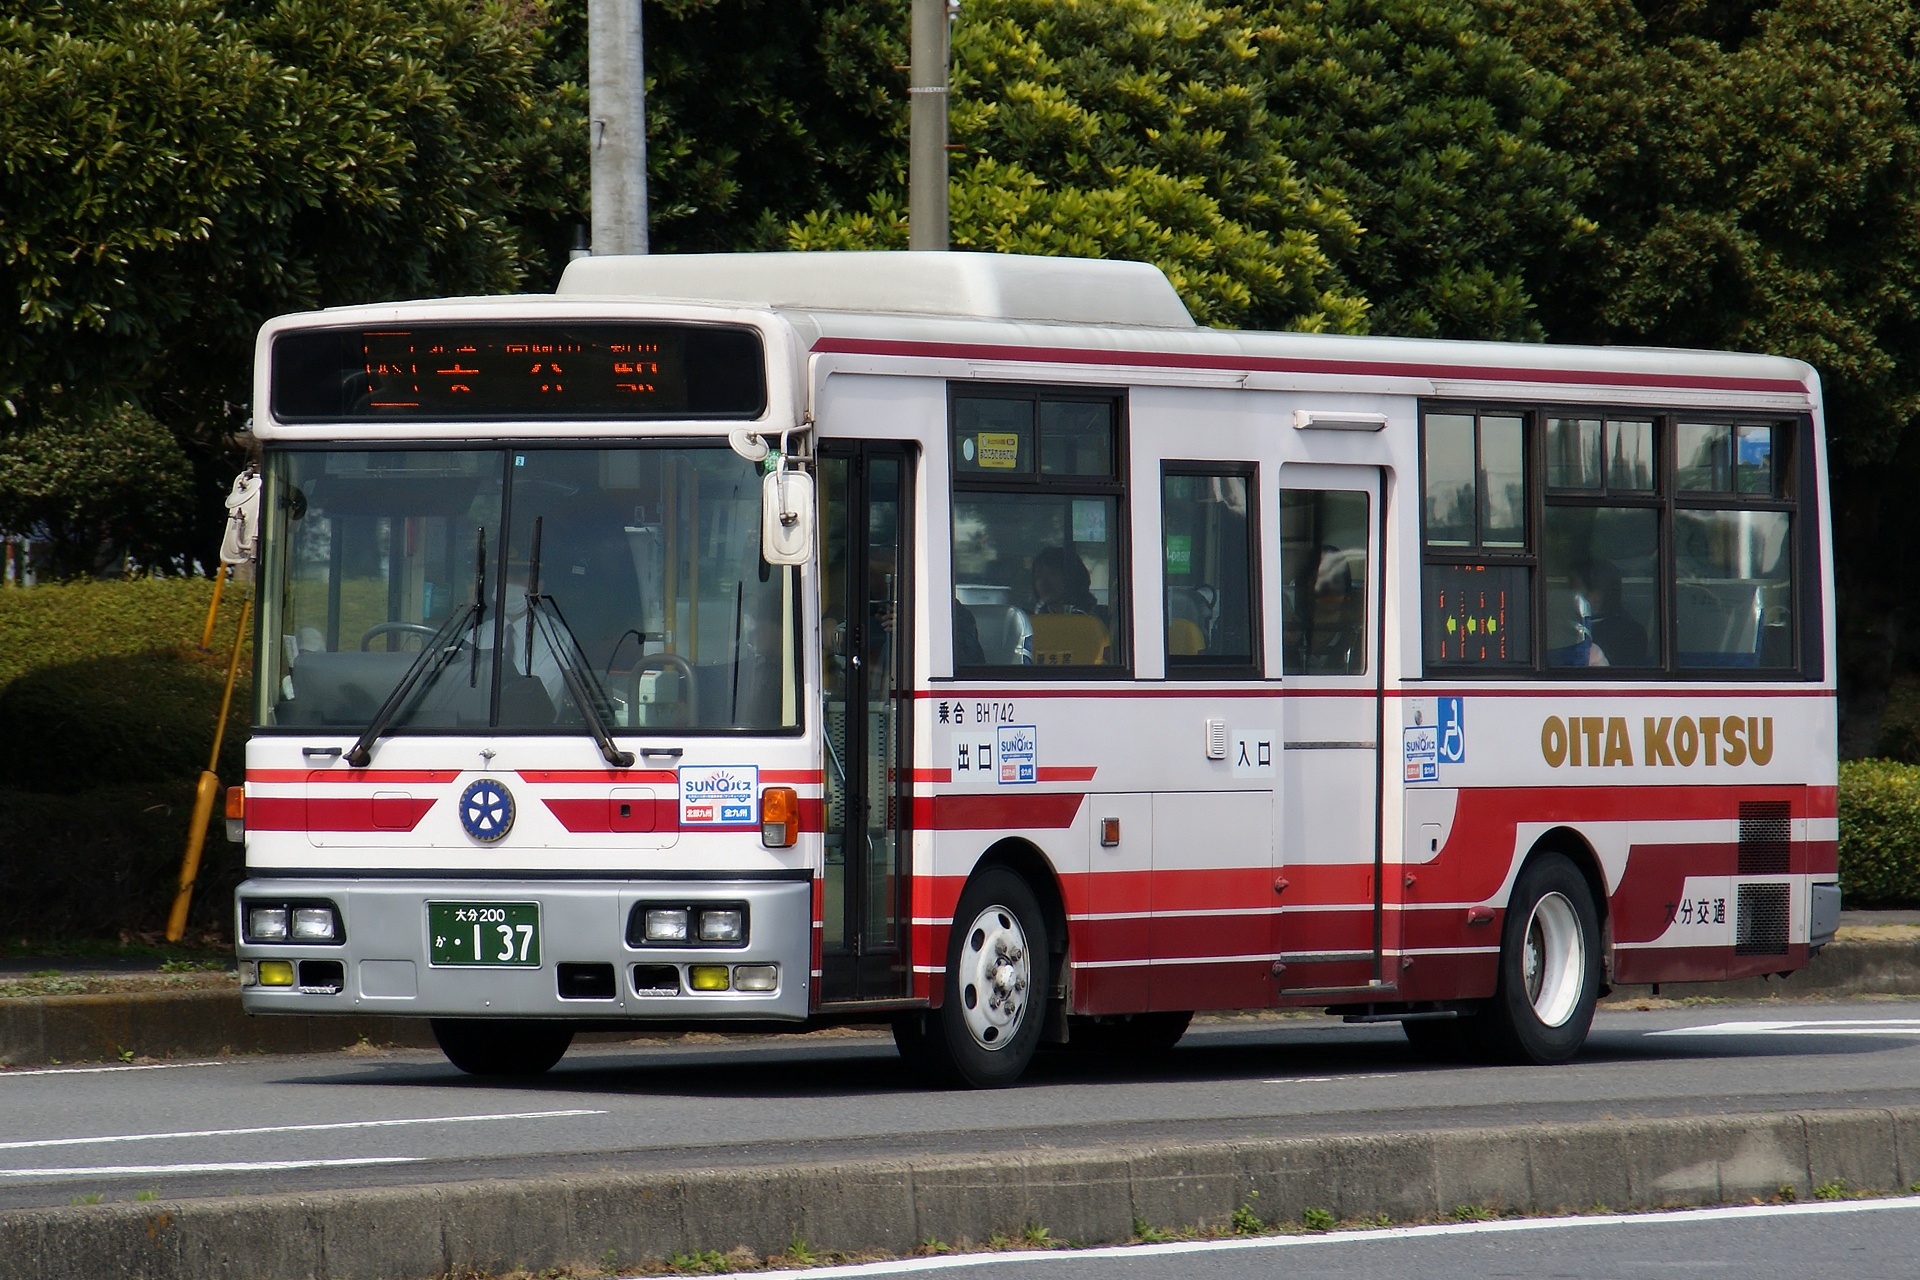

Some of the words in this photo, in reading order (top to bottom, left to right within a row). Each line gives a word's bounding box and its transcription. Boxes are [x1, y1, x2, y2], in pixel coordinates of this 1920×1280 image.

[939, 701, 965, 724] 乗合
[976, 702, 1014, 723] BH742
[1541, 715, 1634, 768] OITA
[1643, 715, 1774, 767] KOTSU
[957, 743, 992, 771] 出口
[1238, 740, 1270, 767] 入口
[685, 778, 752, 793] SUNQパス
[723, 808, 748, 818] 全九州
[455, 909, 506, 923] 大分200
[1663, 898, 1726, 925] 大分交通
[435, 935, 447, 948] か
